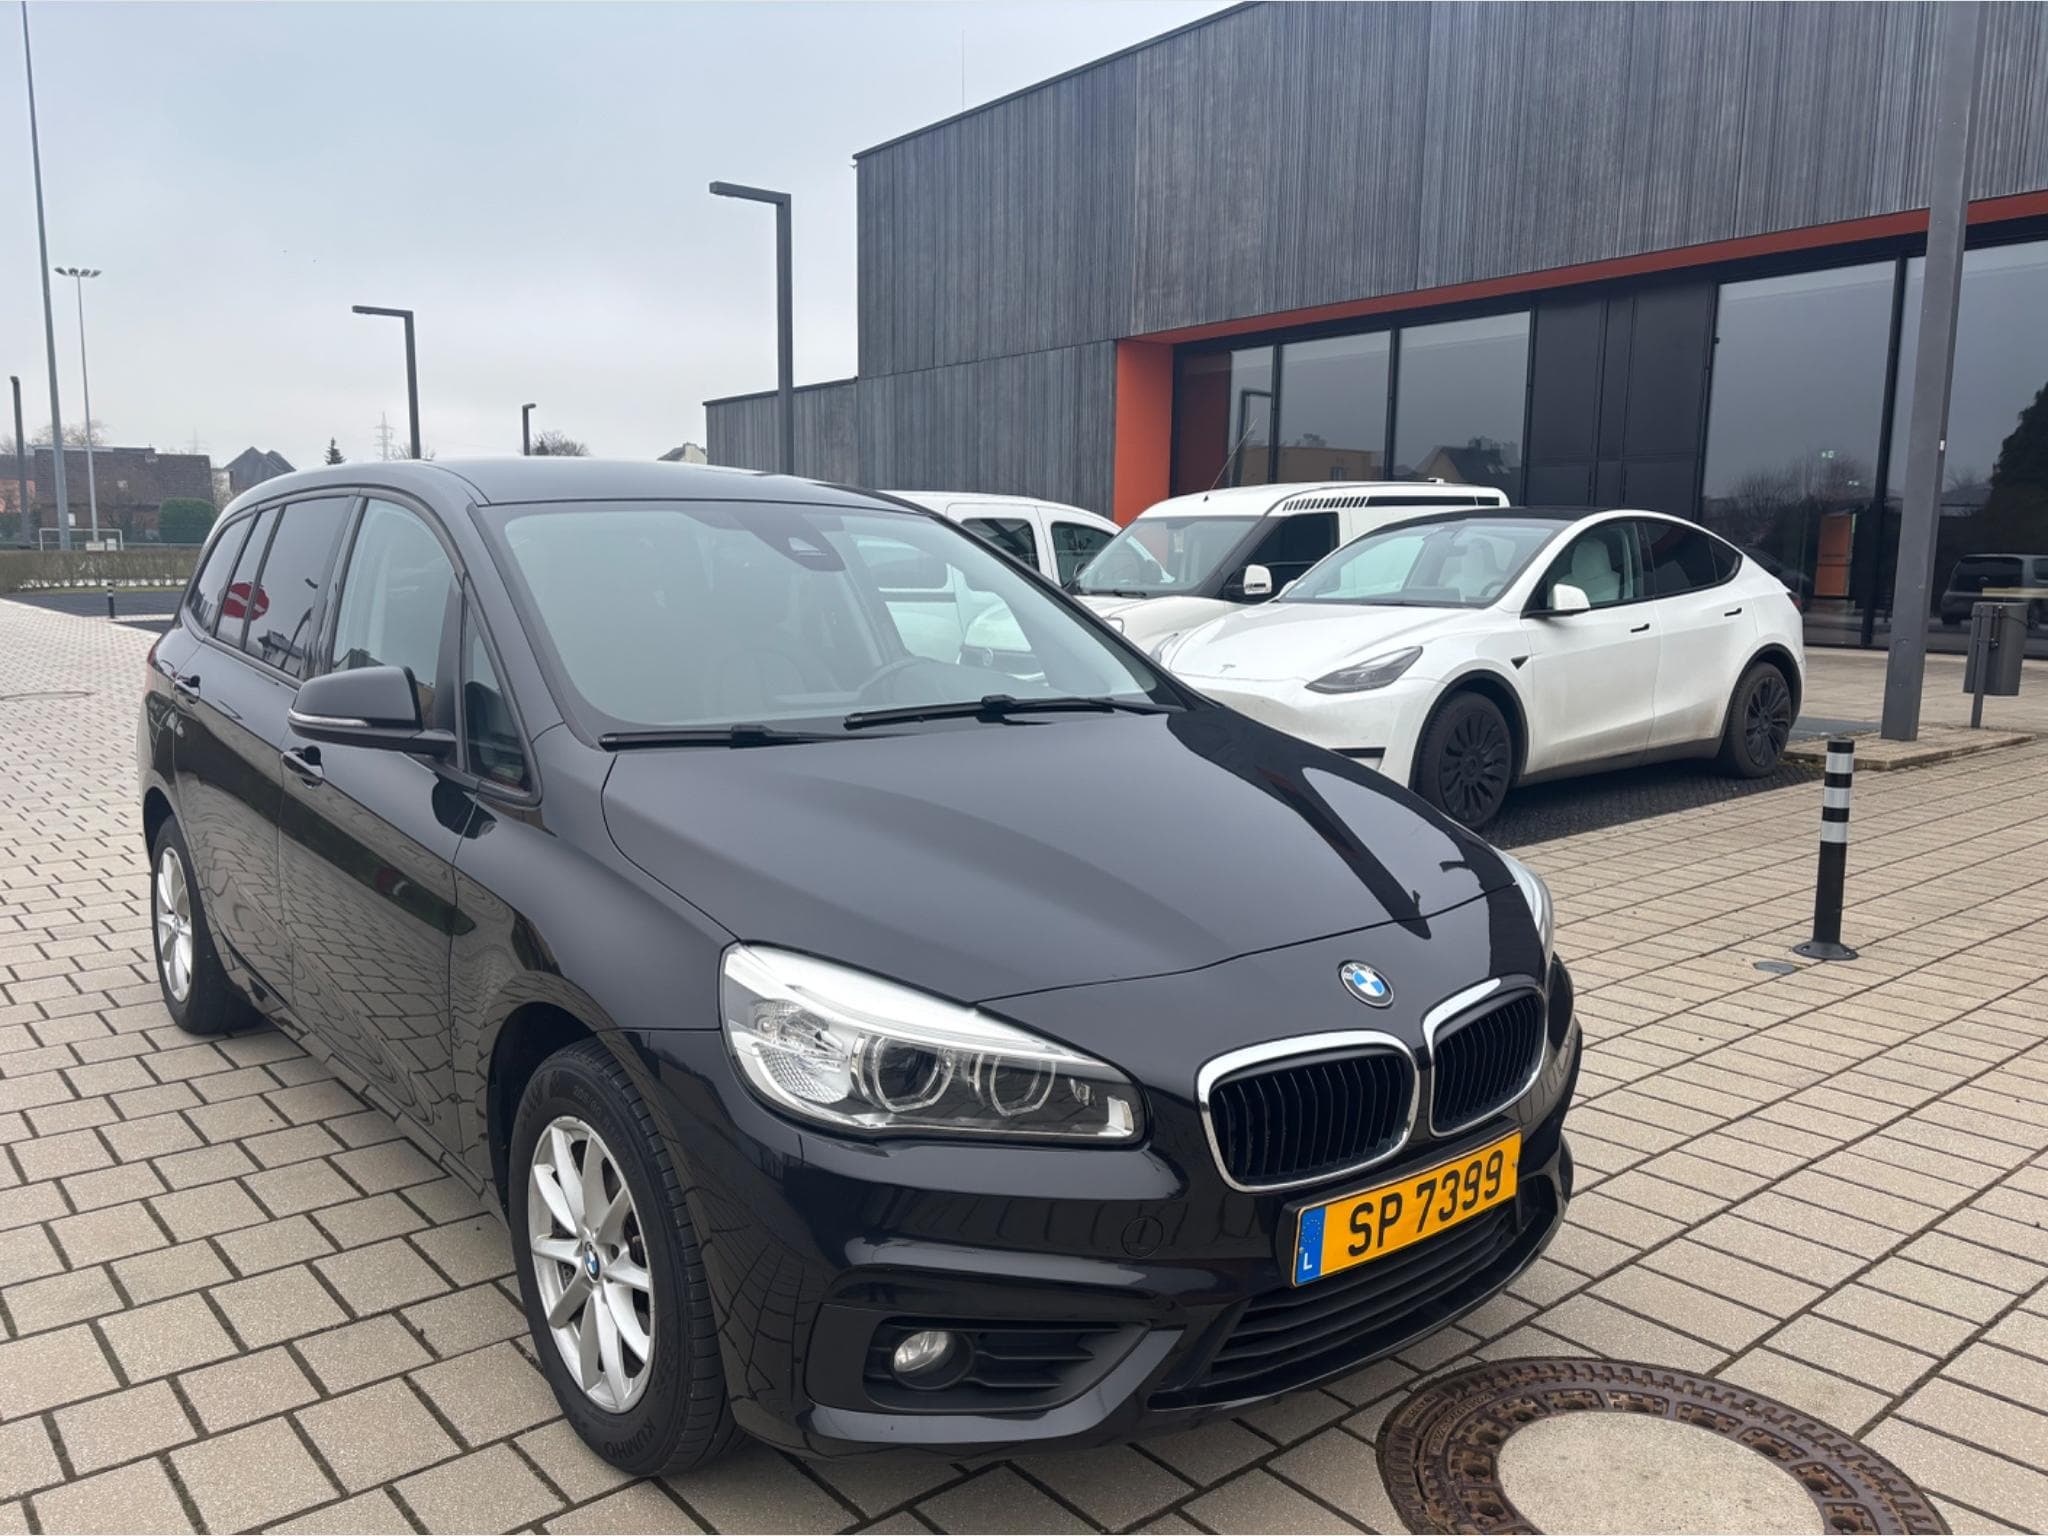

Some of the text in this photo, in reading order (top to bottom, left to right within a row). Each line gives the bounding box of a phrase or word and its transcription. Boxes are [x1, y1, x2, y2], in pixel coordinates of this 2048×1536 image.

[1348, 1150, 1504, 1257] SP 7399
[1302, 1252, 1312, 1271] L
[602, 1415, 656, 1458] KUMHO
